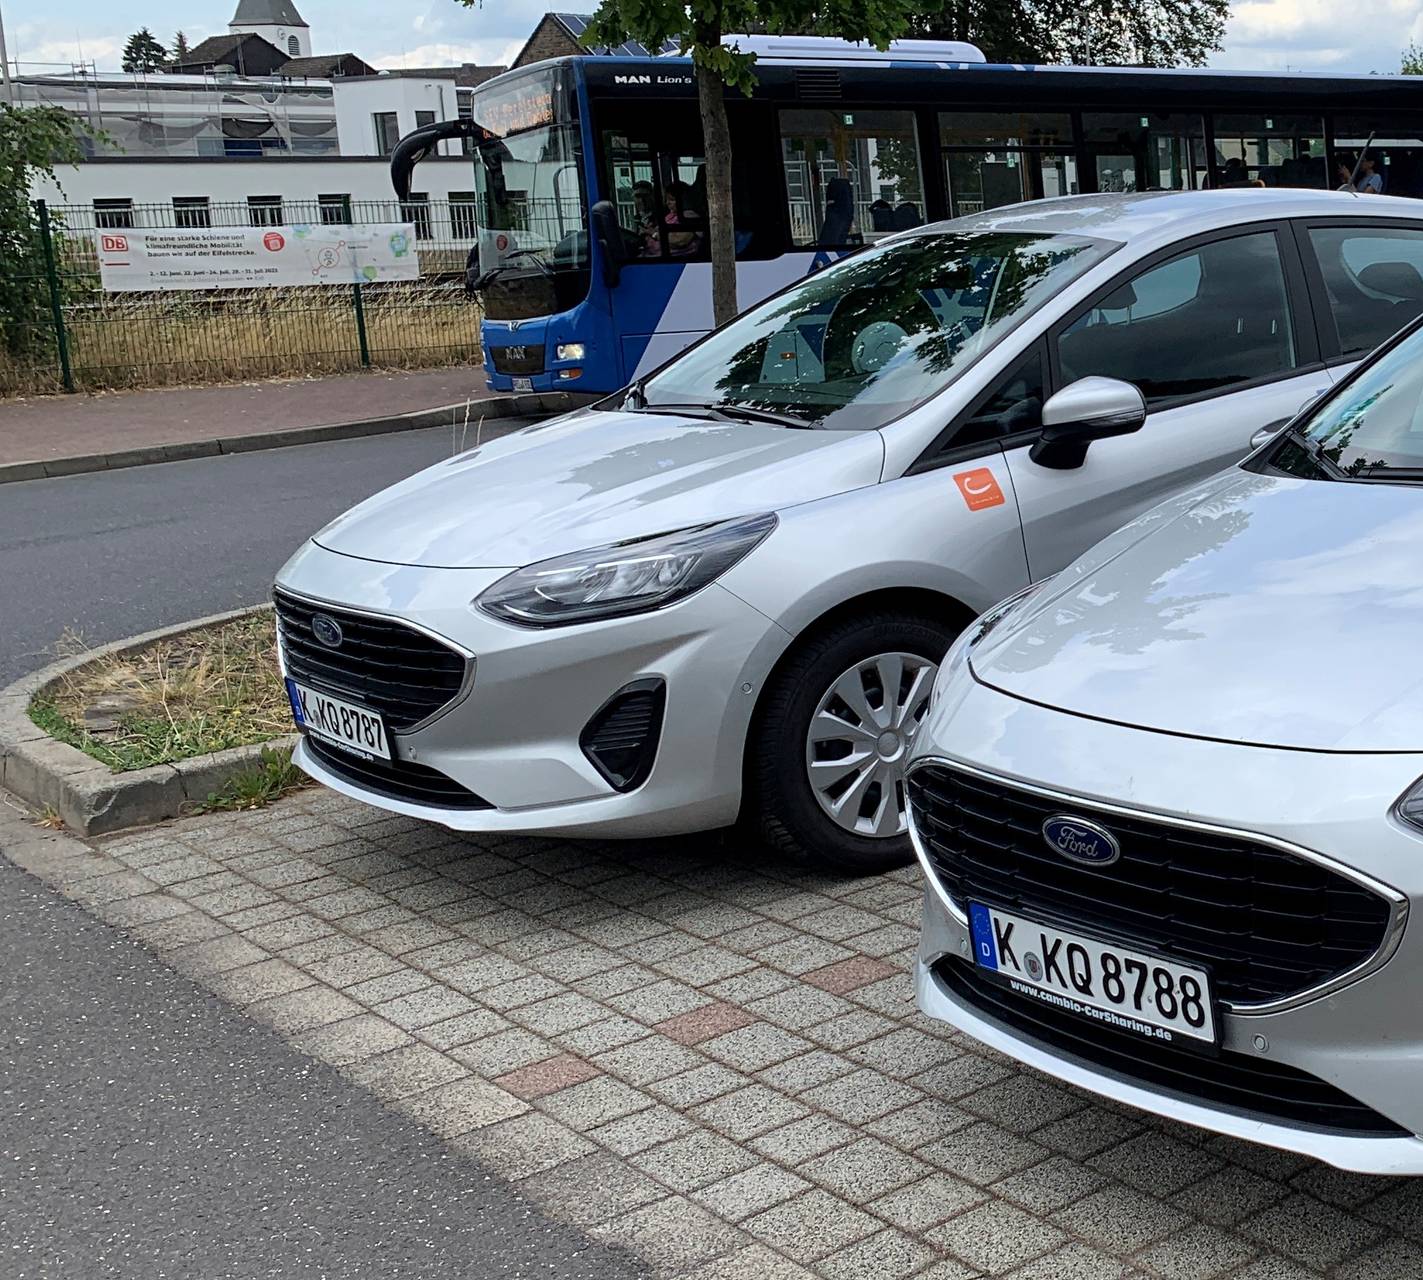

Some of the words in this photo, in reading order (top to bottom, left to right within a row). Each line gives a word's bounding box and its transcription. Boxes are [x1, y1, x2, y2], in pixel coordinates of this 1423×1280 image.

[614, 75, 651, 84] MAN
[657, 75, 692, 84] Lion's
[105, 237, 125, 250] DB
[298, 689, 314, 723] K
[315, 696, 342, 737] KQ
[340, 706, 383, 752] 8787
[1057, 826, 1099, 857] Ford
[981, 942, 991, 958] D
[993, 917, 1021, 971] K
[1040, 932, 1095, 998] KQ
[1100, 951, 1206, 1029] 8788
[1009, 979, 1173, 1041] www.cambio-CarSharing.de
